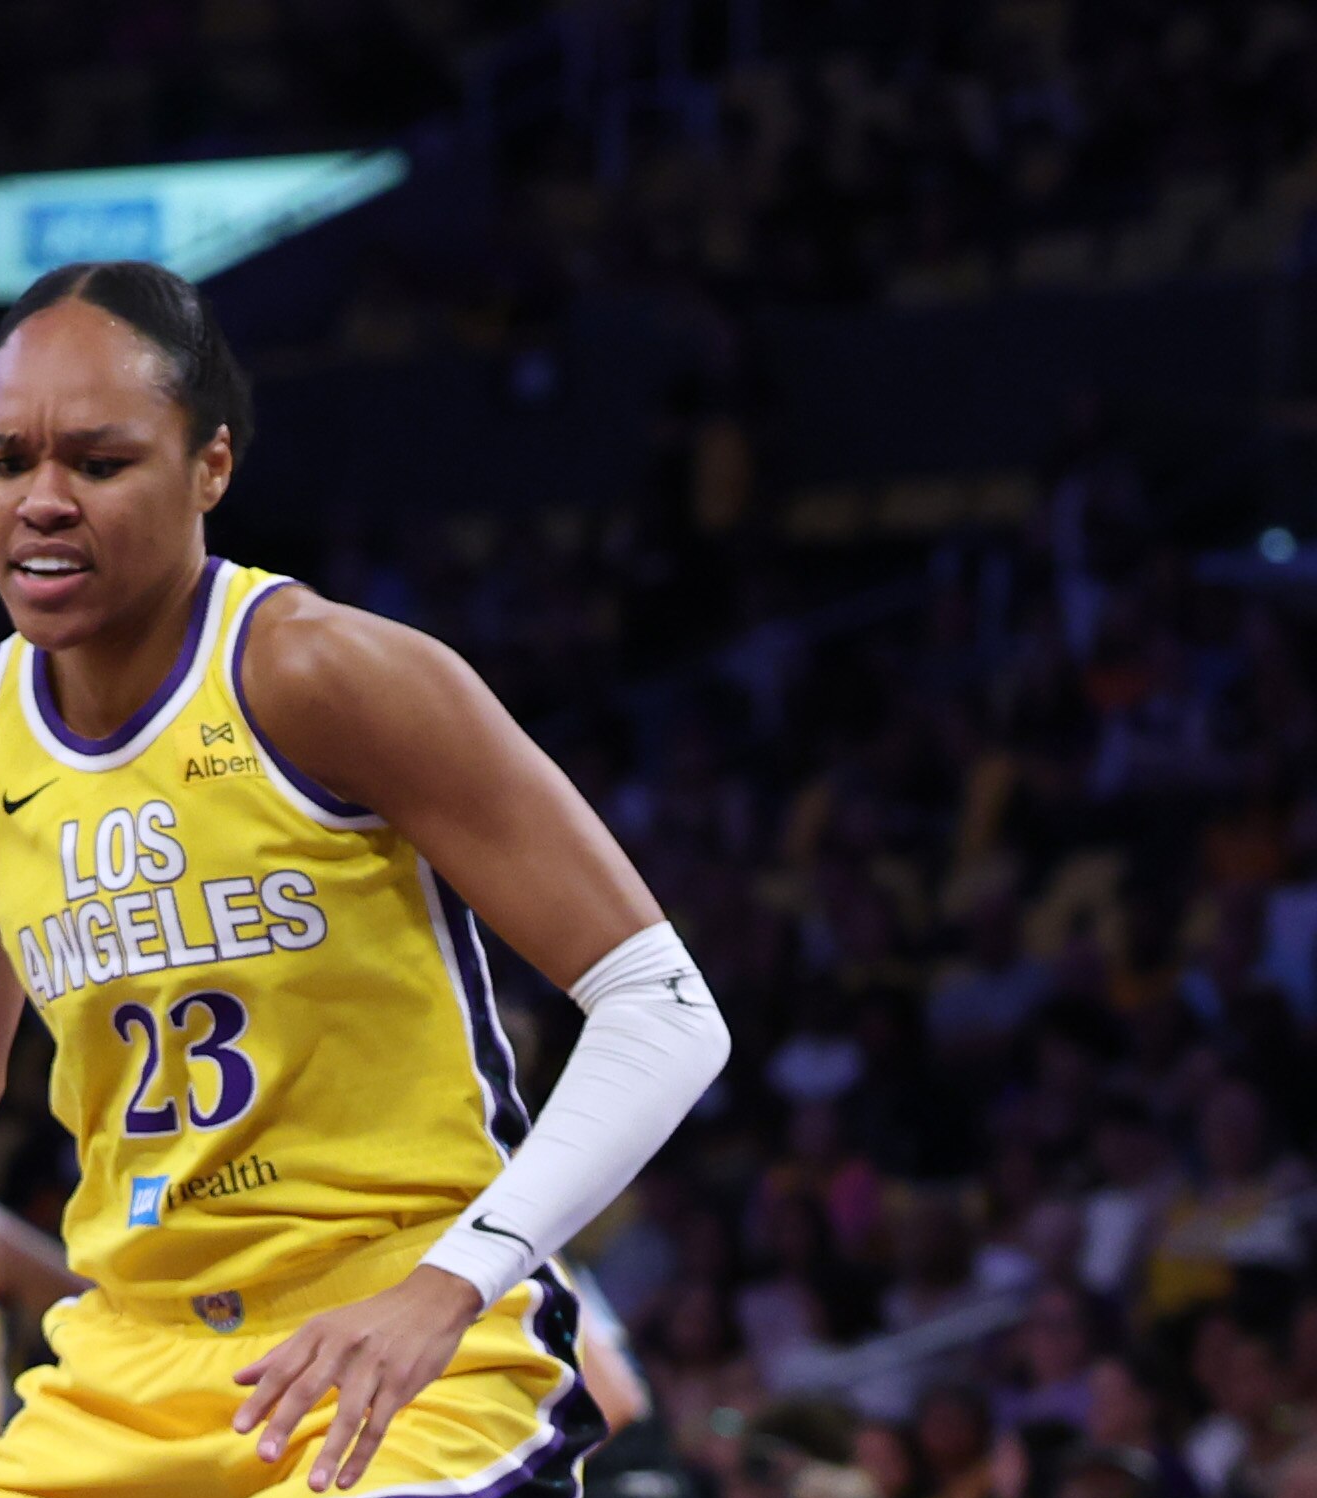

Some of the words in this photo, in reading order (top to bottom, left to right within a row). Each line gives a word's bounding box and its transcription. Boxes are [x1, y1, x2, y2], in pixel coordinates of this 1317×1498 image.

[59, 800, 187, 900] LOS
[18, 869, 328, 1003] ANGELES
[112, 989, 257, 1139] 23
